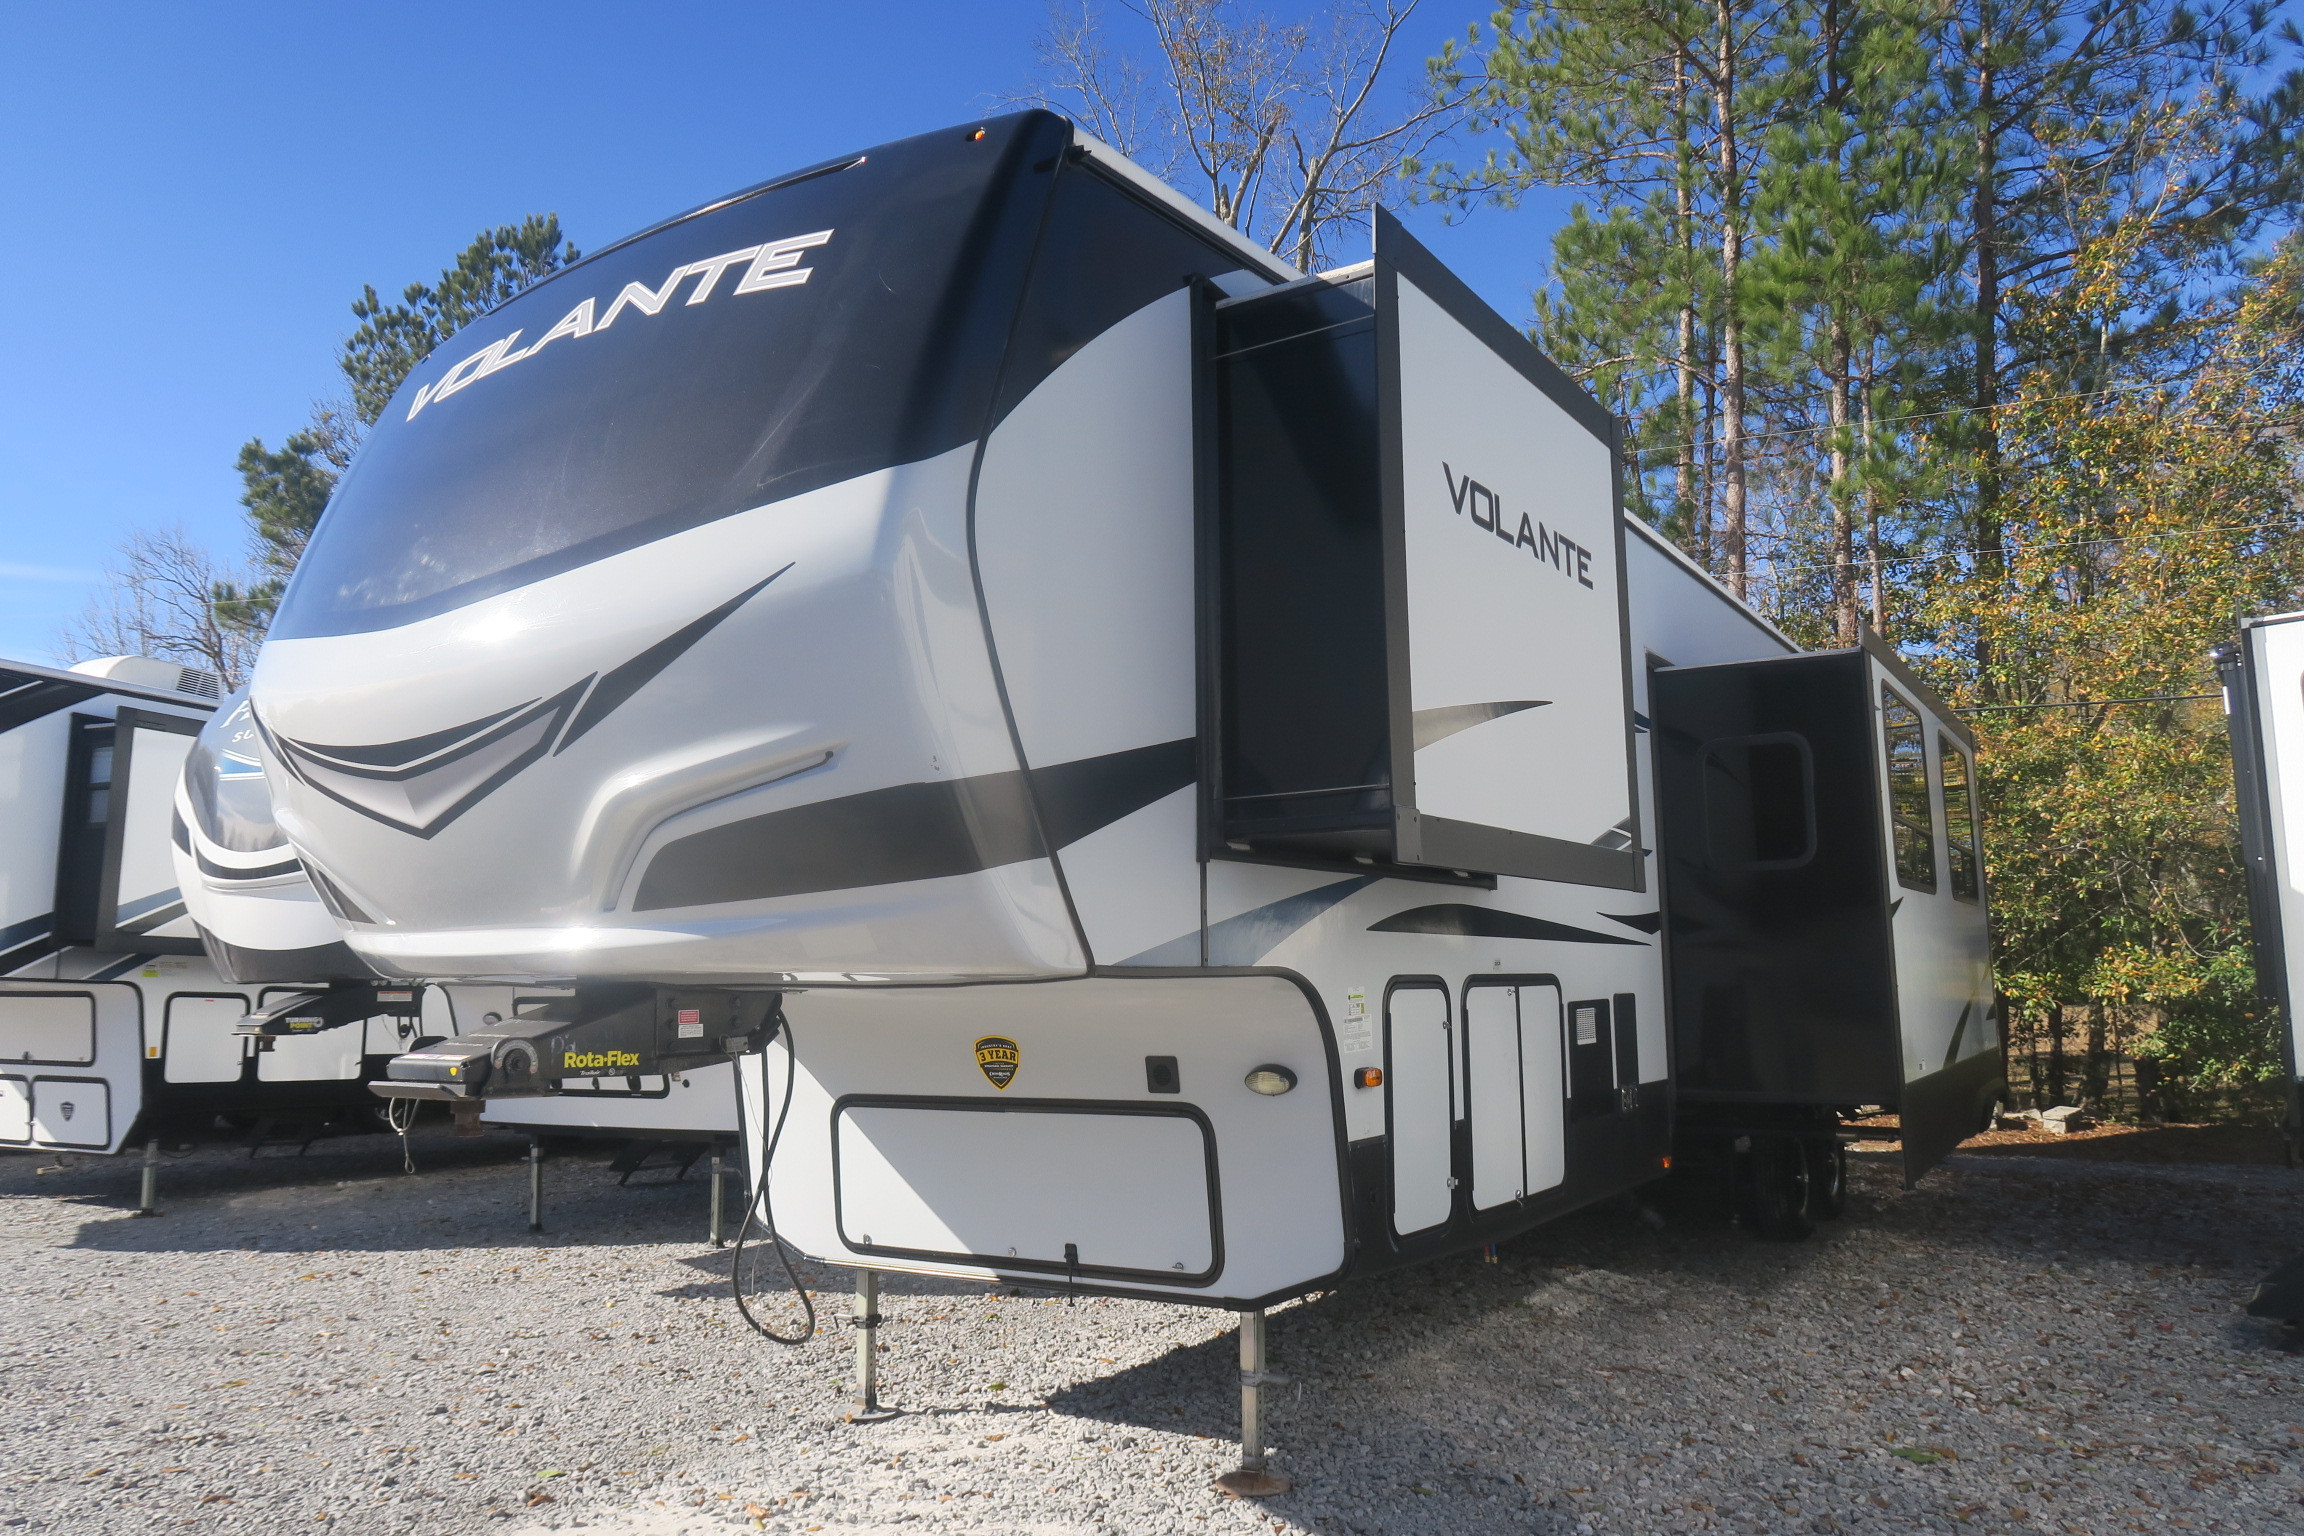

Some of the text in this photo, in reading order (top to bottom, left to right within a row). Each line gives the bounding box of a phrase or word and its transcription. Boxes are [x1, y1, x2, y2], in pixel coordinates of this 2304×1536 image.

[406, 228, 835, 422] VOLANTE
[1442, 460, 1594, 590] VOLANTE
[979, 1049, 1016, 1062] 3 YEAR
